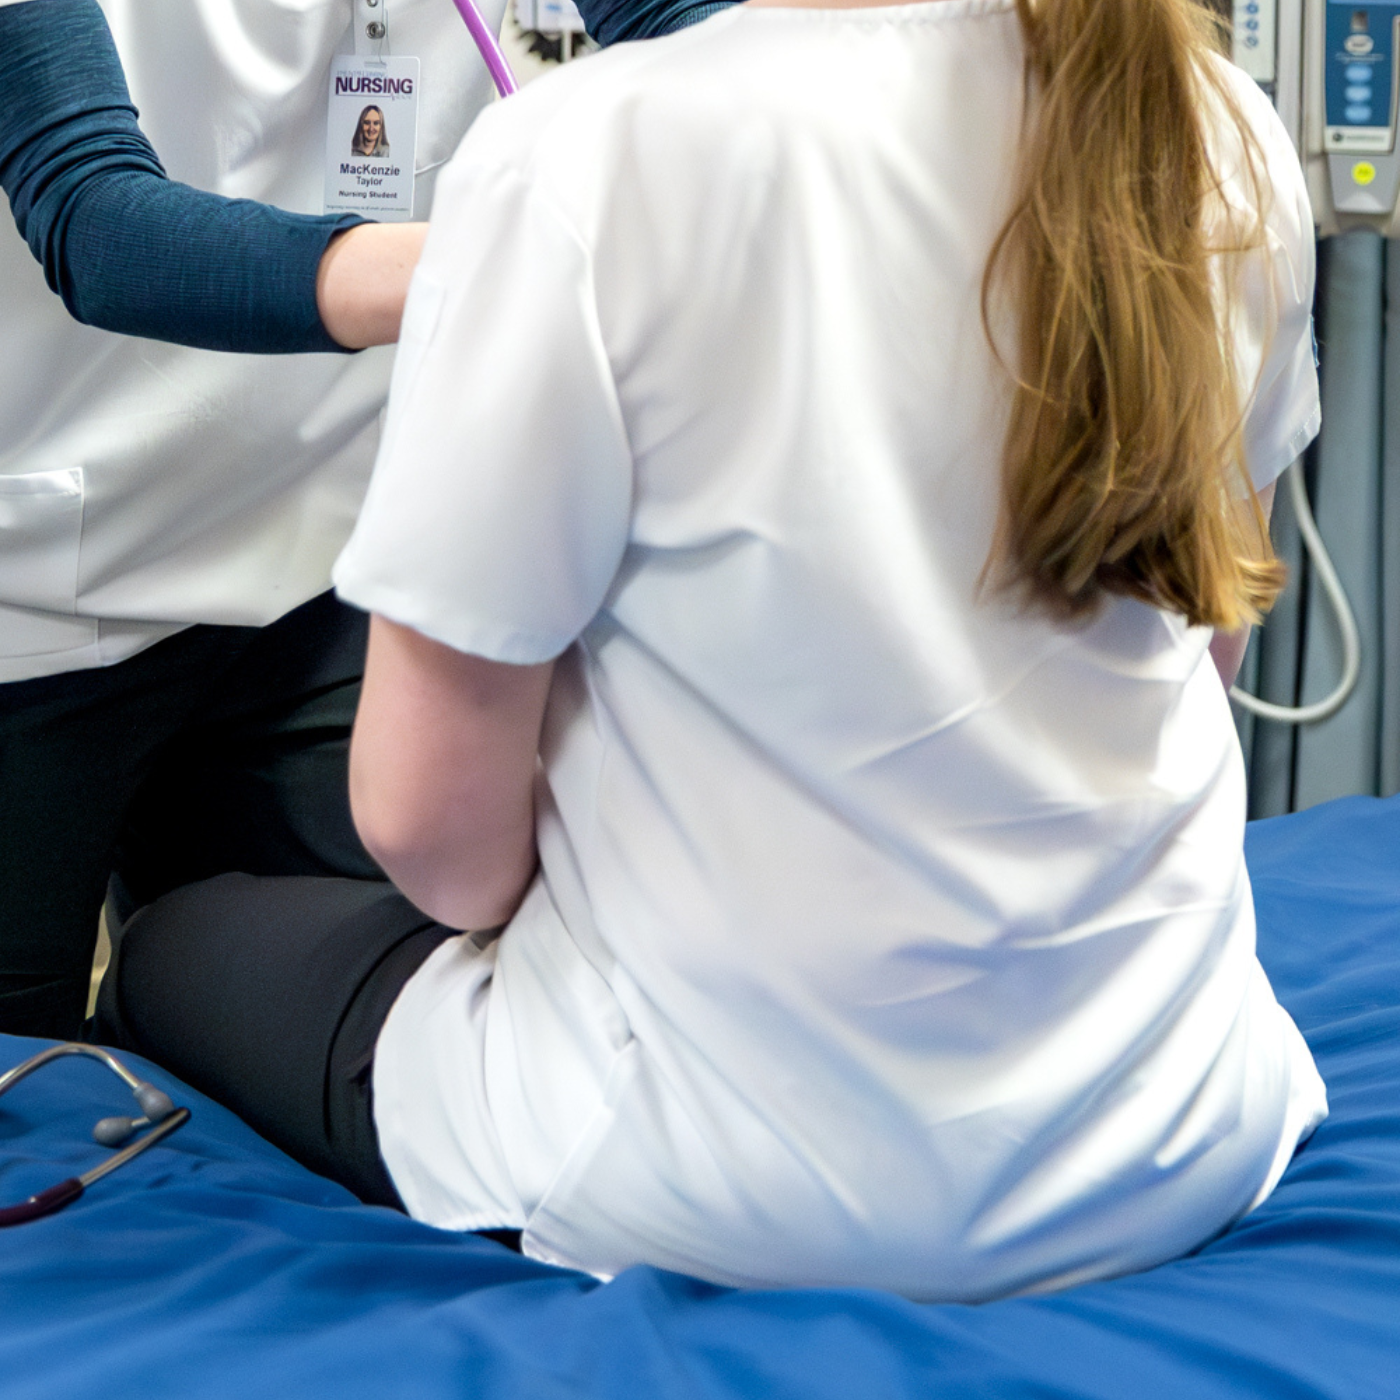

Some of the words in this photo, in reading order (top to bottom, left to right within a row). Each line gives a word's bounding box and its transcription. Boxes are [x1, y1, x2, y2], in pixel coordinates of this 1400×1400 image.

[335, 76, 413, 95] NURSING
[339, 163, 400, 176] MacKenzie
[356, 176, 383, 187] Taylor
[338, 190, 367, 199] Nursing
[369, 191, 398, 199] Student
